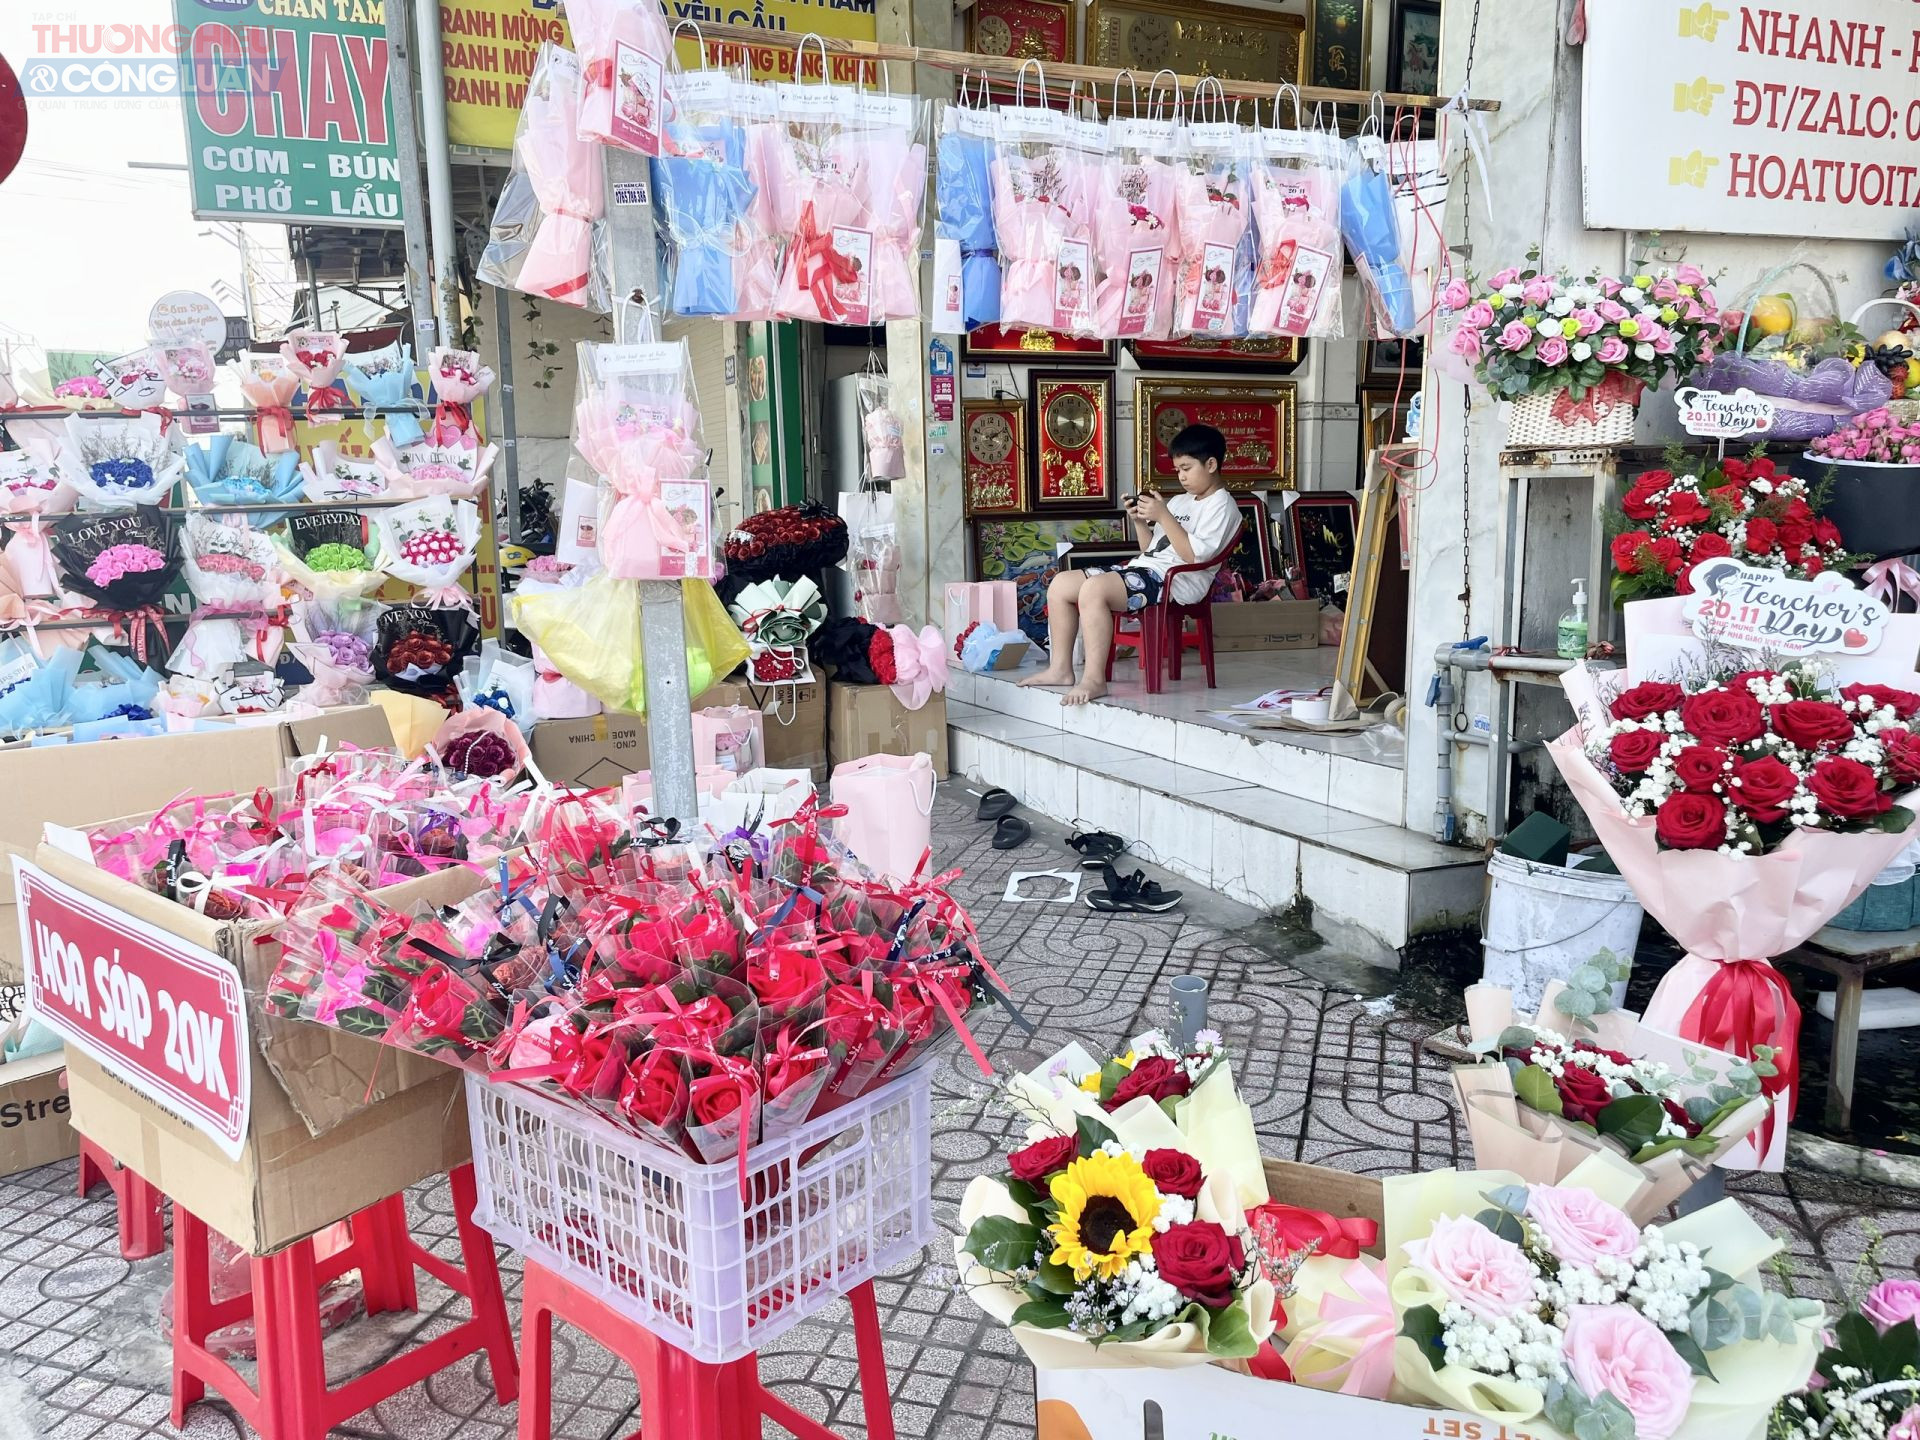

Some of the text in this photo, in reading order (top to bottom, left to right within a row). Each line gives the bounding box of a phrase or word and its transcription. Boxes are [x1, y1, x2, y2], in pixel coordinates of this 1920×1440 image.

[1738, 6, 1885, 69] NHANH
[190, 22, 389, 146] CHAY
[1733, 80, 1898, 140] ĐT/ZALO:
[202, 145, 289, 175] CƠM
[327, 151, 400, 181] BÚN
[215, 179, 291, 210] PHỞ
[331, 182, 398, 217] LẨU
[1686, 411, 1717, 423] 20.11
[67, 516, 142, 545] LOVE YOU
[294, 513, 361, 531] EVERYDAY
[1740, 573, 1775, 583] HAPPY
[1698, 599, 1760, 625] 20.11
[1742, 582, 1880, 626] Teacher's
[568, 730, 636, 744] MADE CHINA
[35, 919, 92, 1020] HOA
[93, 948, 152, 1050] SÁP
[157, 990, 230, 1101] 20K
[1423, 1416, 1482, 1439] SET
